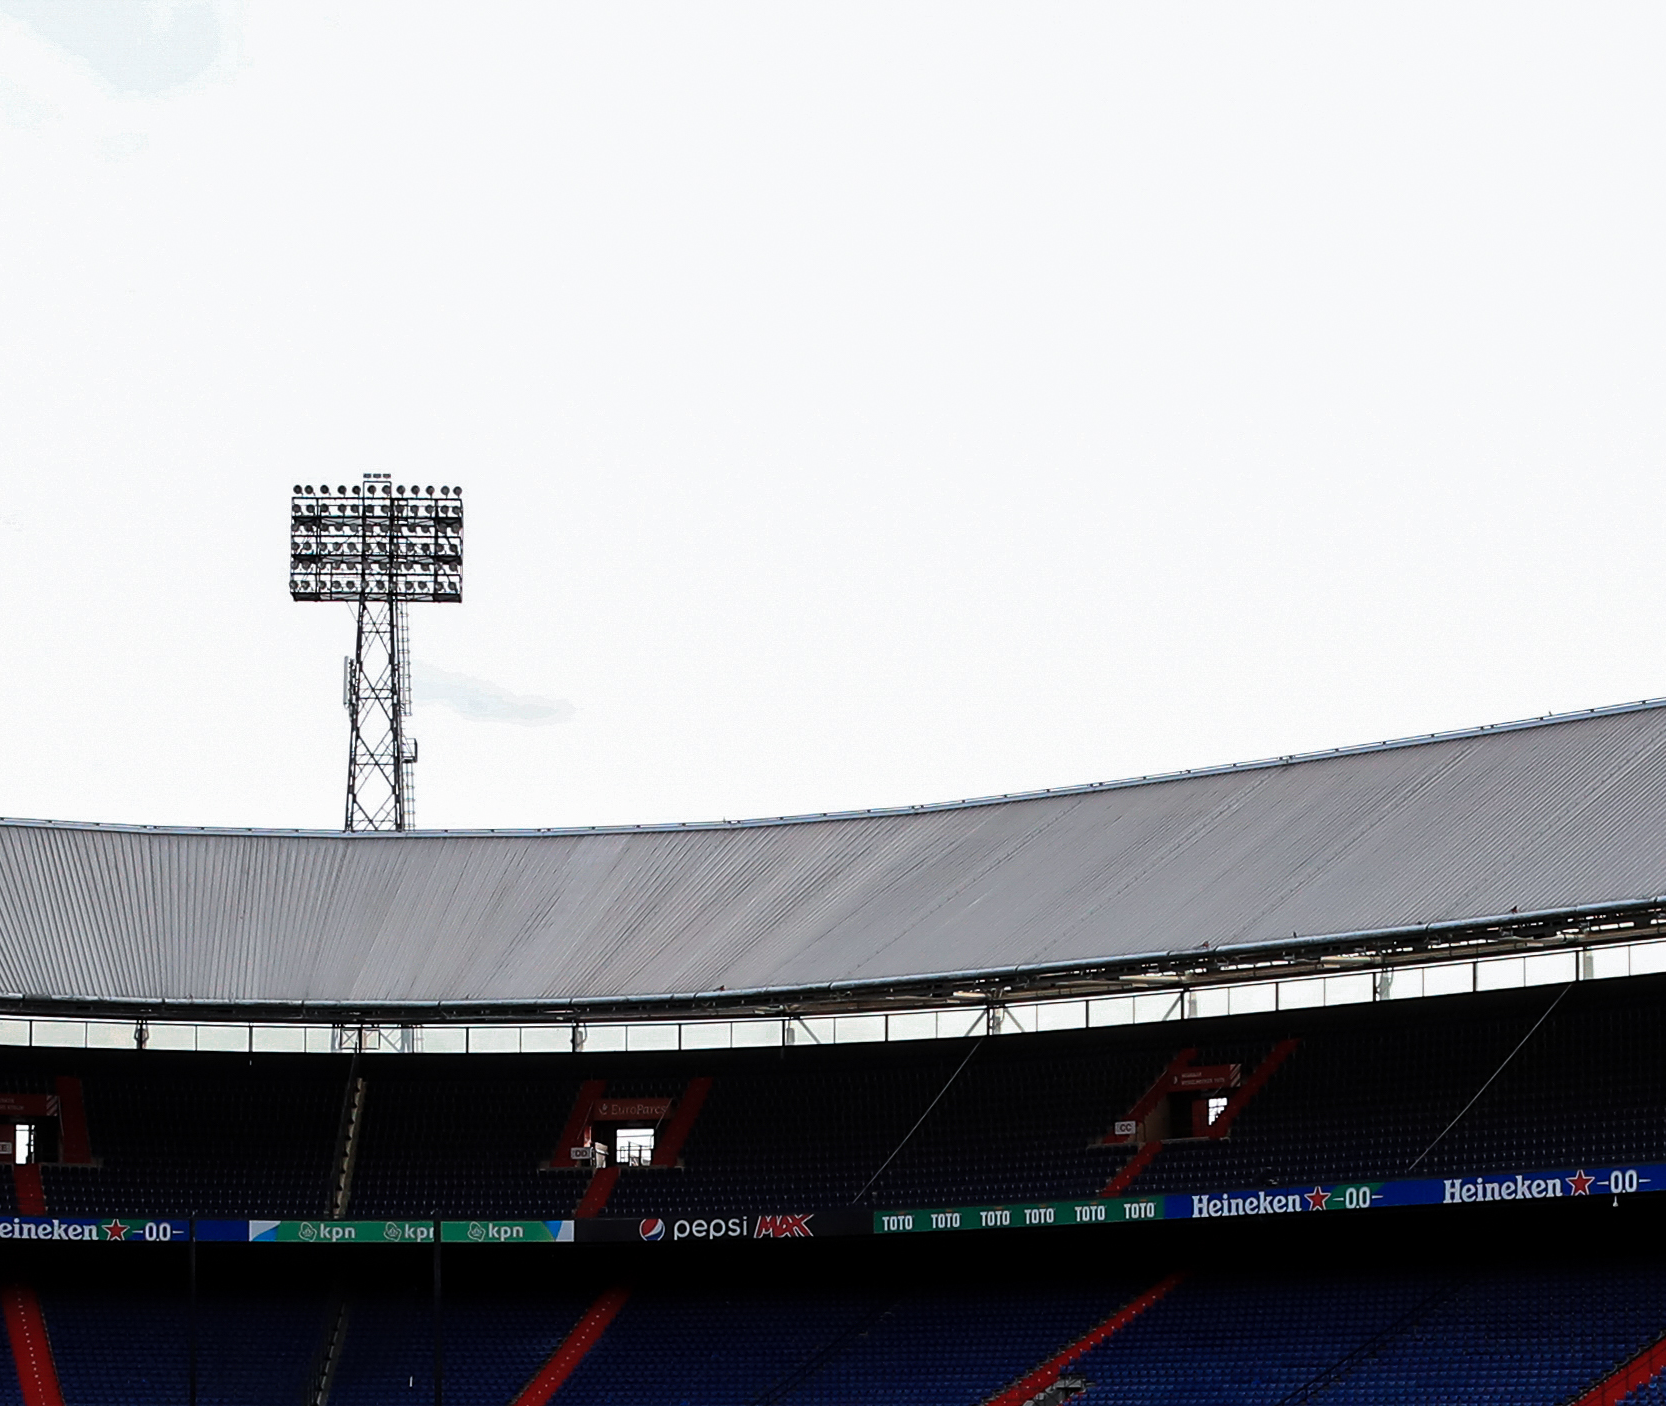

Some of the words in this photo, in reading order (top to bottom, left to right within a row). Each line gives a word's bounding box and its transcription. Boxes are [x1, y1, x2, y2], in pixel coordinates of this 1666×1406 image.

[1443, 1175, 1563, 1204] Heineken
[1124, 1202, 1155, 1219] TOTO
[1191, 1191, 1302, 1218] Heineken
[931, 1213, 961, 1229] TOTO
[980, 1211, 1010, 1227] TOTO
[1024, 1208, 1055, 1224] TOTO
[1075, 1206, 1105, 1222] TOTO
[488, 1223, 524, 1241] kpn
[674, 1215, 748, 1240] pepsi
[882, 1216, 913, 1231] TOTO
[320, 1224, 356, 1241] kpn
